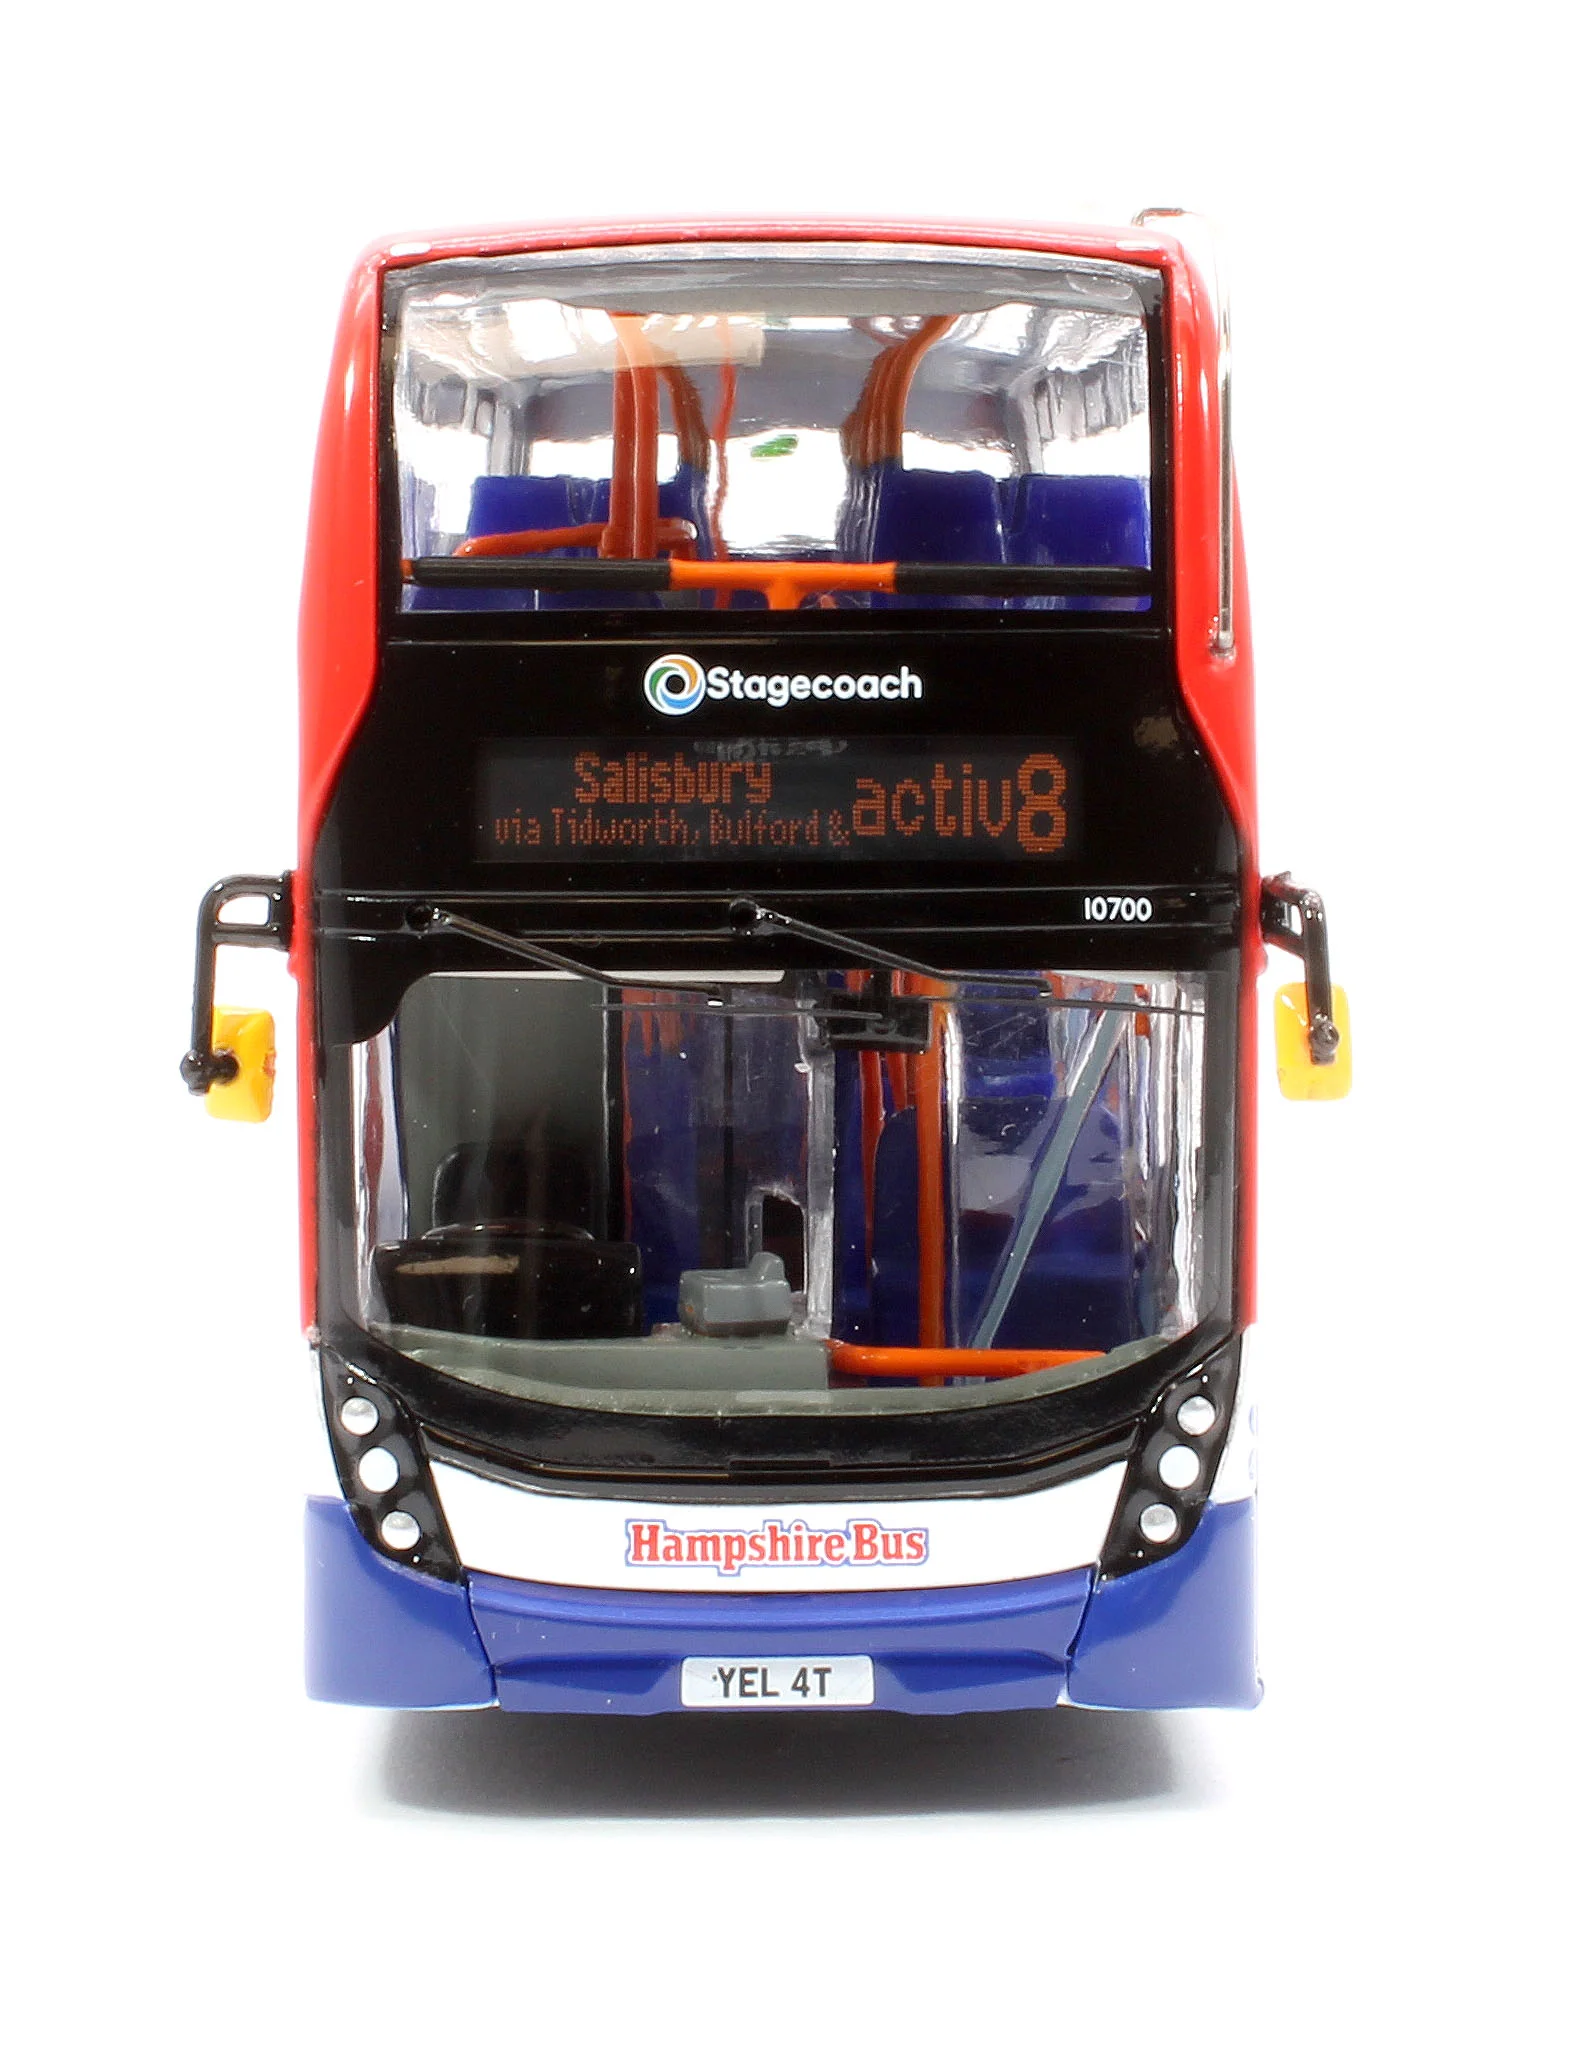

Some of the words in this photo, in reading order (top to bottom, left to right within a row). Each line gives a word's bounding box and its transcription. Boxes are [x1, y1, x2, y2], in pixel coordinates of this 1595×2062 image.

[706, 665, 923, 708] Stagecoach
[574, 751, 772, 803] Salisbury
[495, 807, 541, 845] via
[828, 808, 850, 846] &
[1084, 897, 1152, 922] 10700
[630, 1523, 846, 1571] Hampshire
[853, 1523, 926, 1561] Bus
[717, 1667, 779, 1698] YEL
[791, 1667, 832, 1698] 4T
